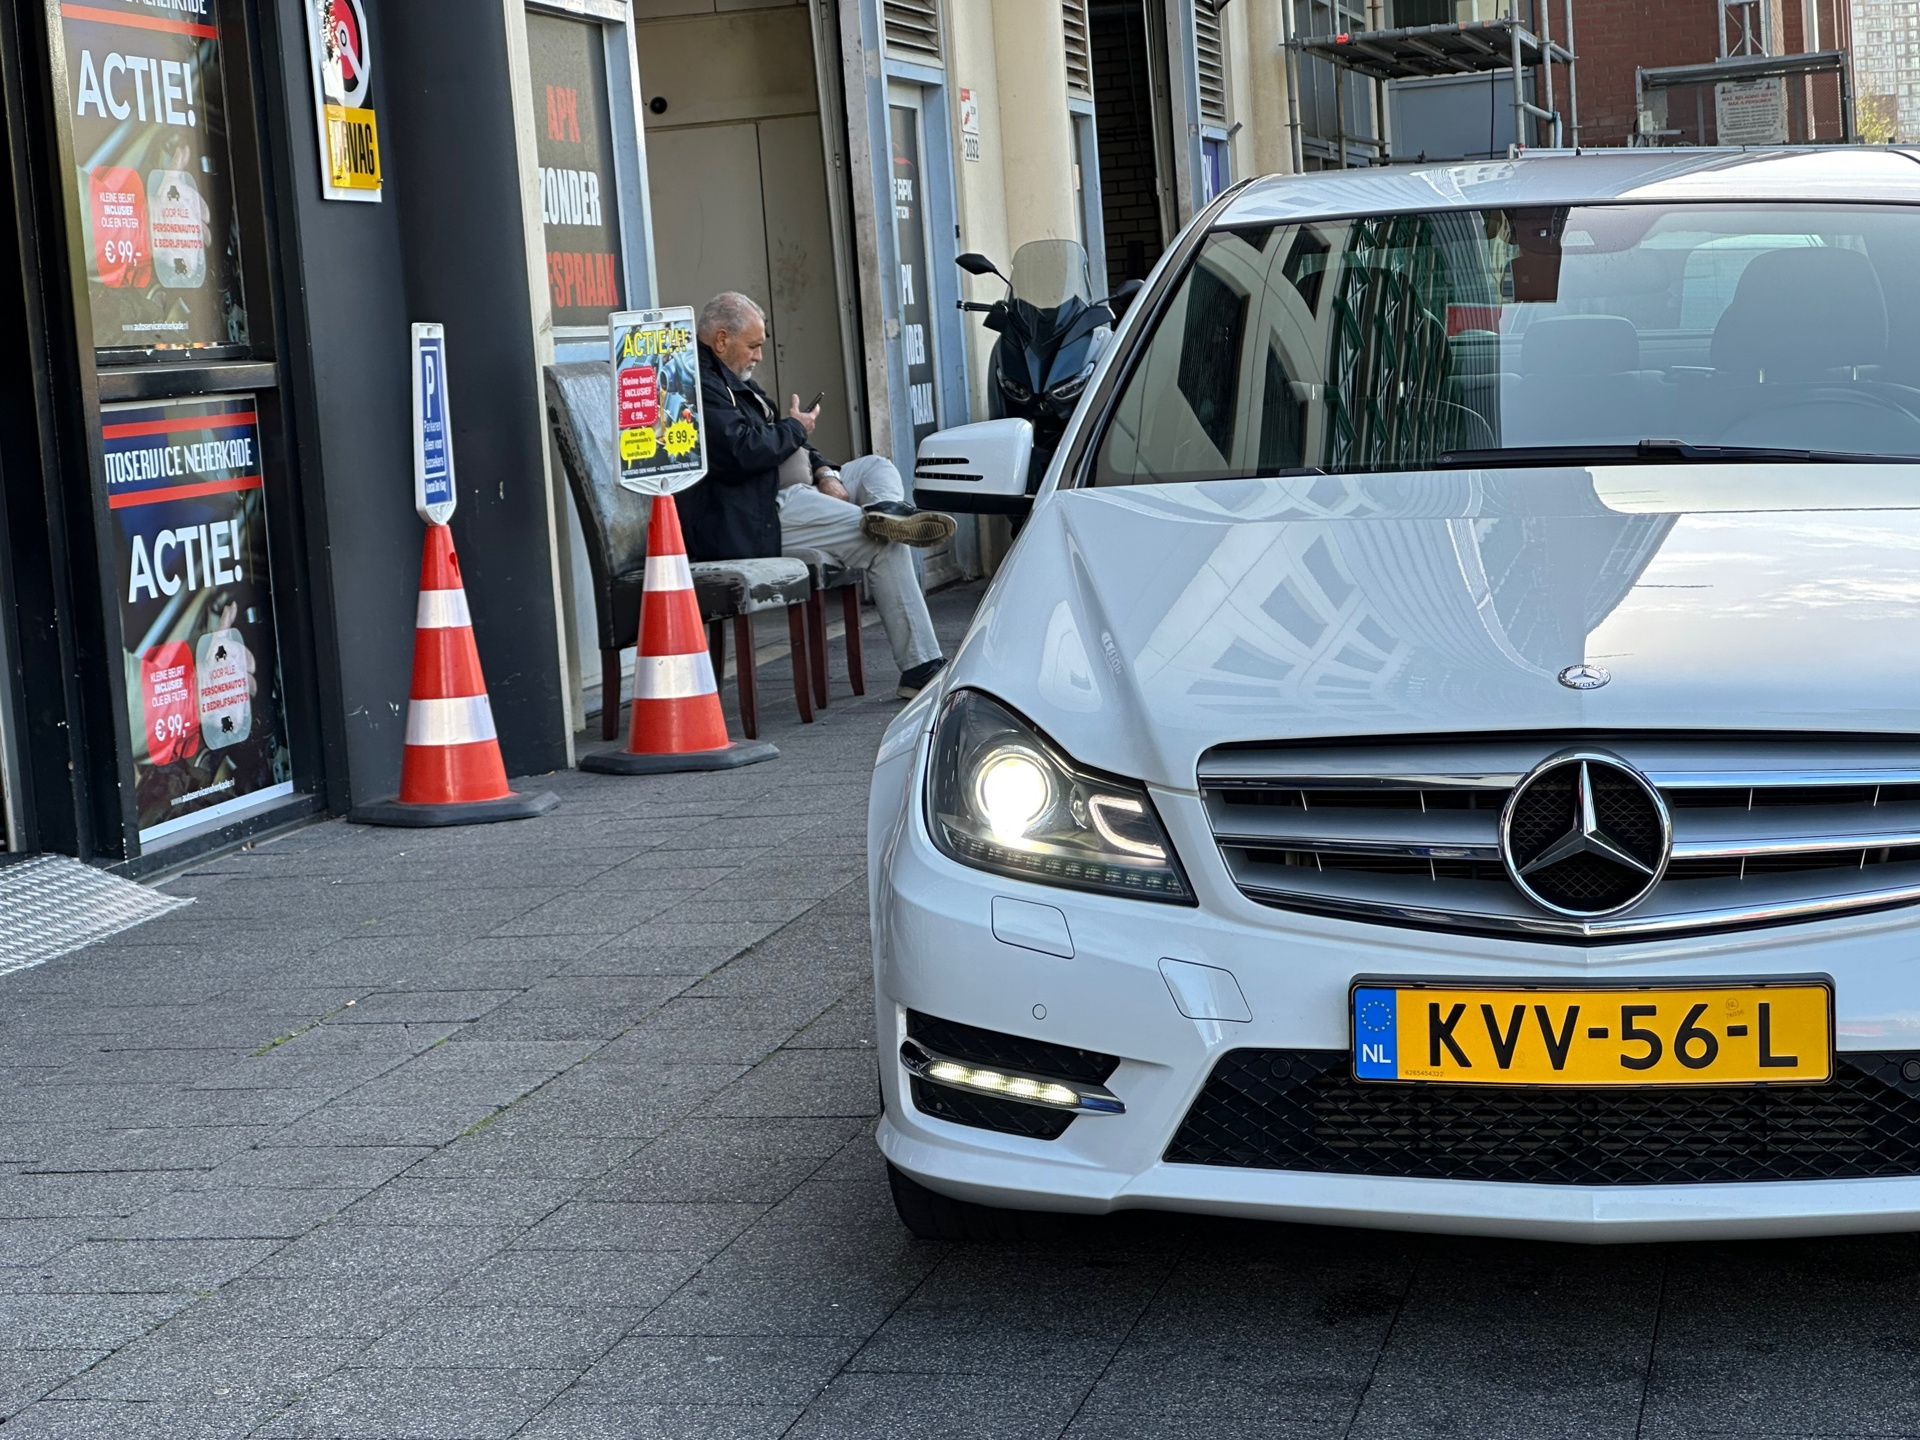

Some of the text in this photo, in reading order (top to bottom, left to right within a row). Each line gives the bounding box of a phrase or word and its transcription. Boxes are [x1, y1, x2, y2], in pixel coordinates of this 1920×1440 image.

[77, 49, 196, 127] ACTIE!
[546, 84, 581, 143] APK
[104, 205, 134, 215] INCLUSIEF
[153, 223, 201, 234] PERSONENAUTO'S
[118, 240, 142, 266] 99,-
[546, 252, 619, 308] FSPRAAK
[901, 264, 915, 305] PK
[623, 327, 686, 358] ACTIE!!!
[425, 355, 435, 418] P
[622, 375, 653, 386] Kleine beurt
[624, 387, 652, 398] INCLUSIEF
[622, 401, 633, 410] Olie
[641, 399, 655, 408] Filter
[676, 430, 694, 445] 99,-
[184, 438, 253, 474] NEHERKADE
[128, 519, 242, 603] ACTIE!
[154, 678, 183, 694] INCLUSIEF
[201, 678, 246, 697] PERSONENAUTO'S
[155, 713, 190, 742] € 99,-
[1428, 1002, 1798, 1070] KVV-56-L
[1362, 1044, 1392, 1064] NL
